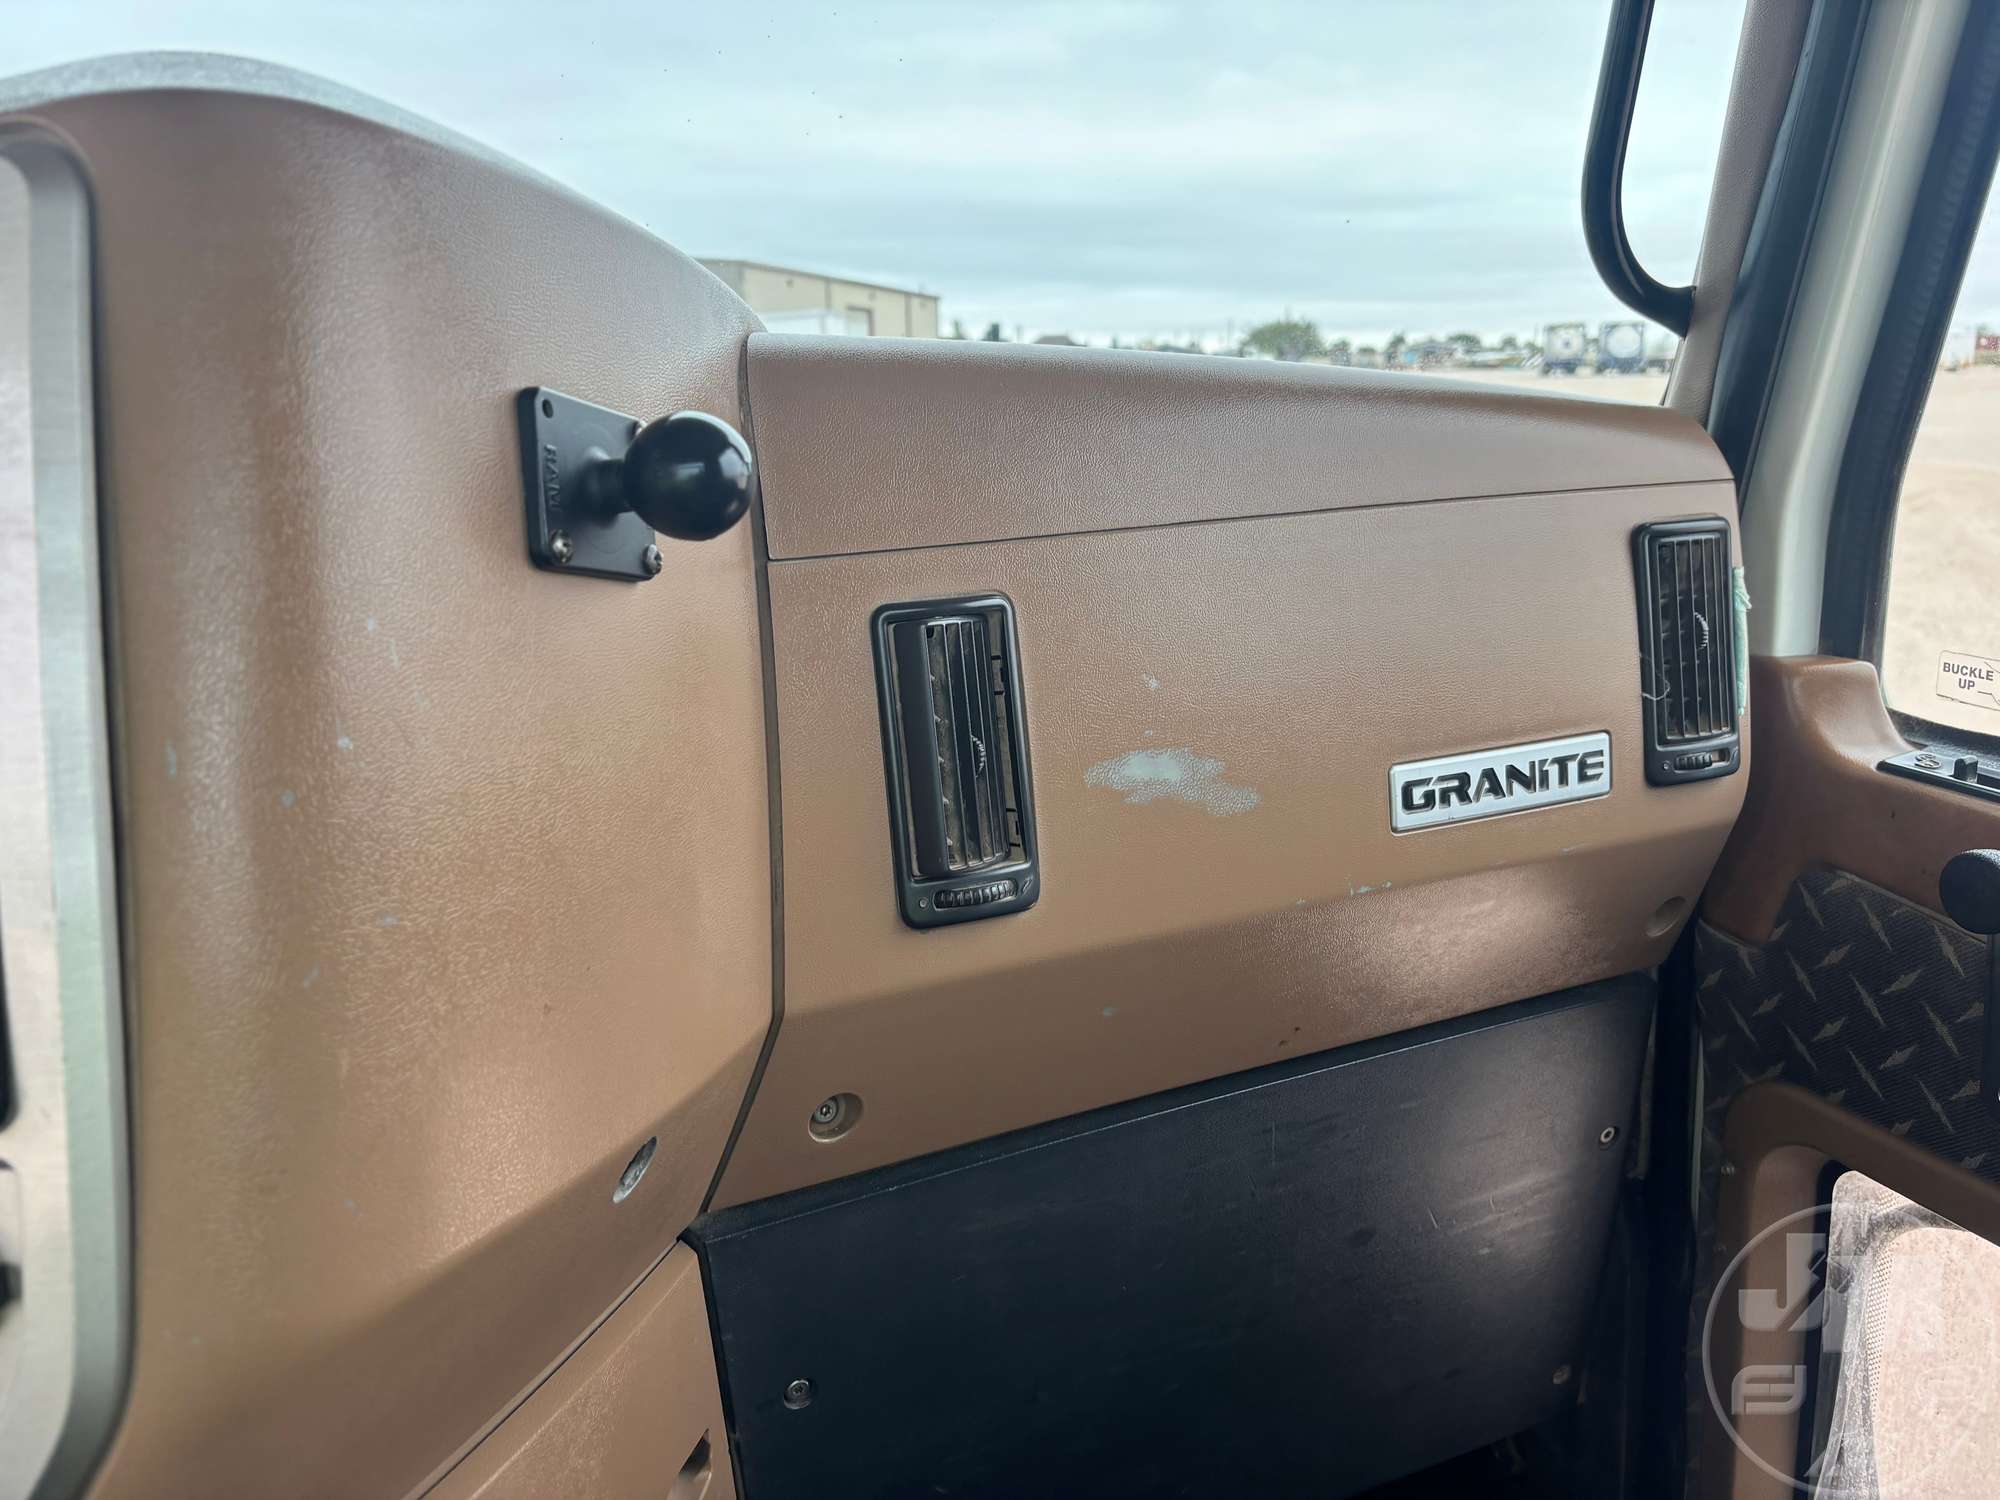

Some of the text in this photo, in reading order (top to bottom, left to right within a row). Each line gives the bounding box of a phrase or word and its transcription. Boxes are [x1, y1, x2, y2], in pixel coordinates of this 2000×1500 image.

[1943, 662, 1994, 681] BUCKLE
[1958, 678, 1976, 690] UP
[1401, 749, 1604, 815] GRANITE
